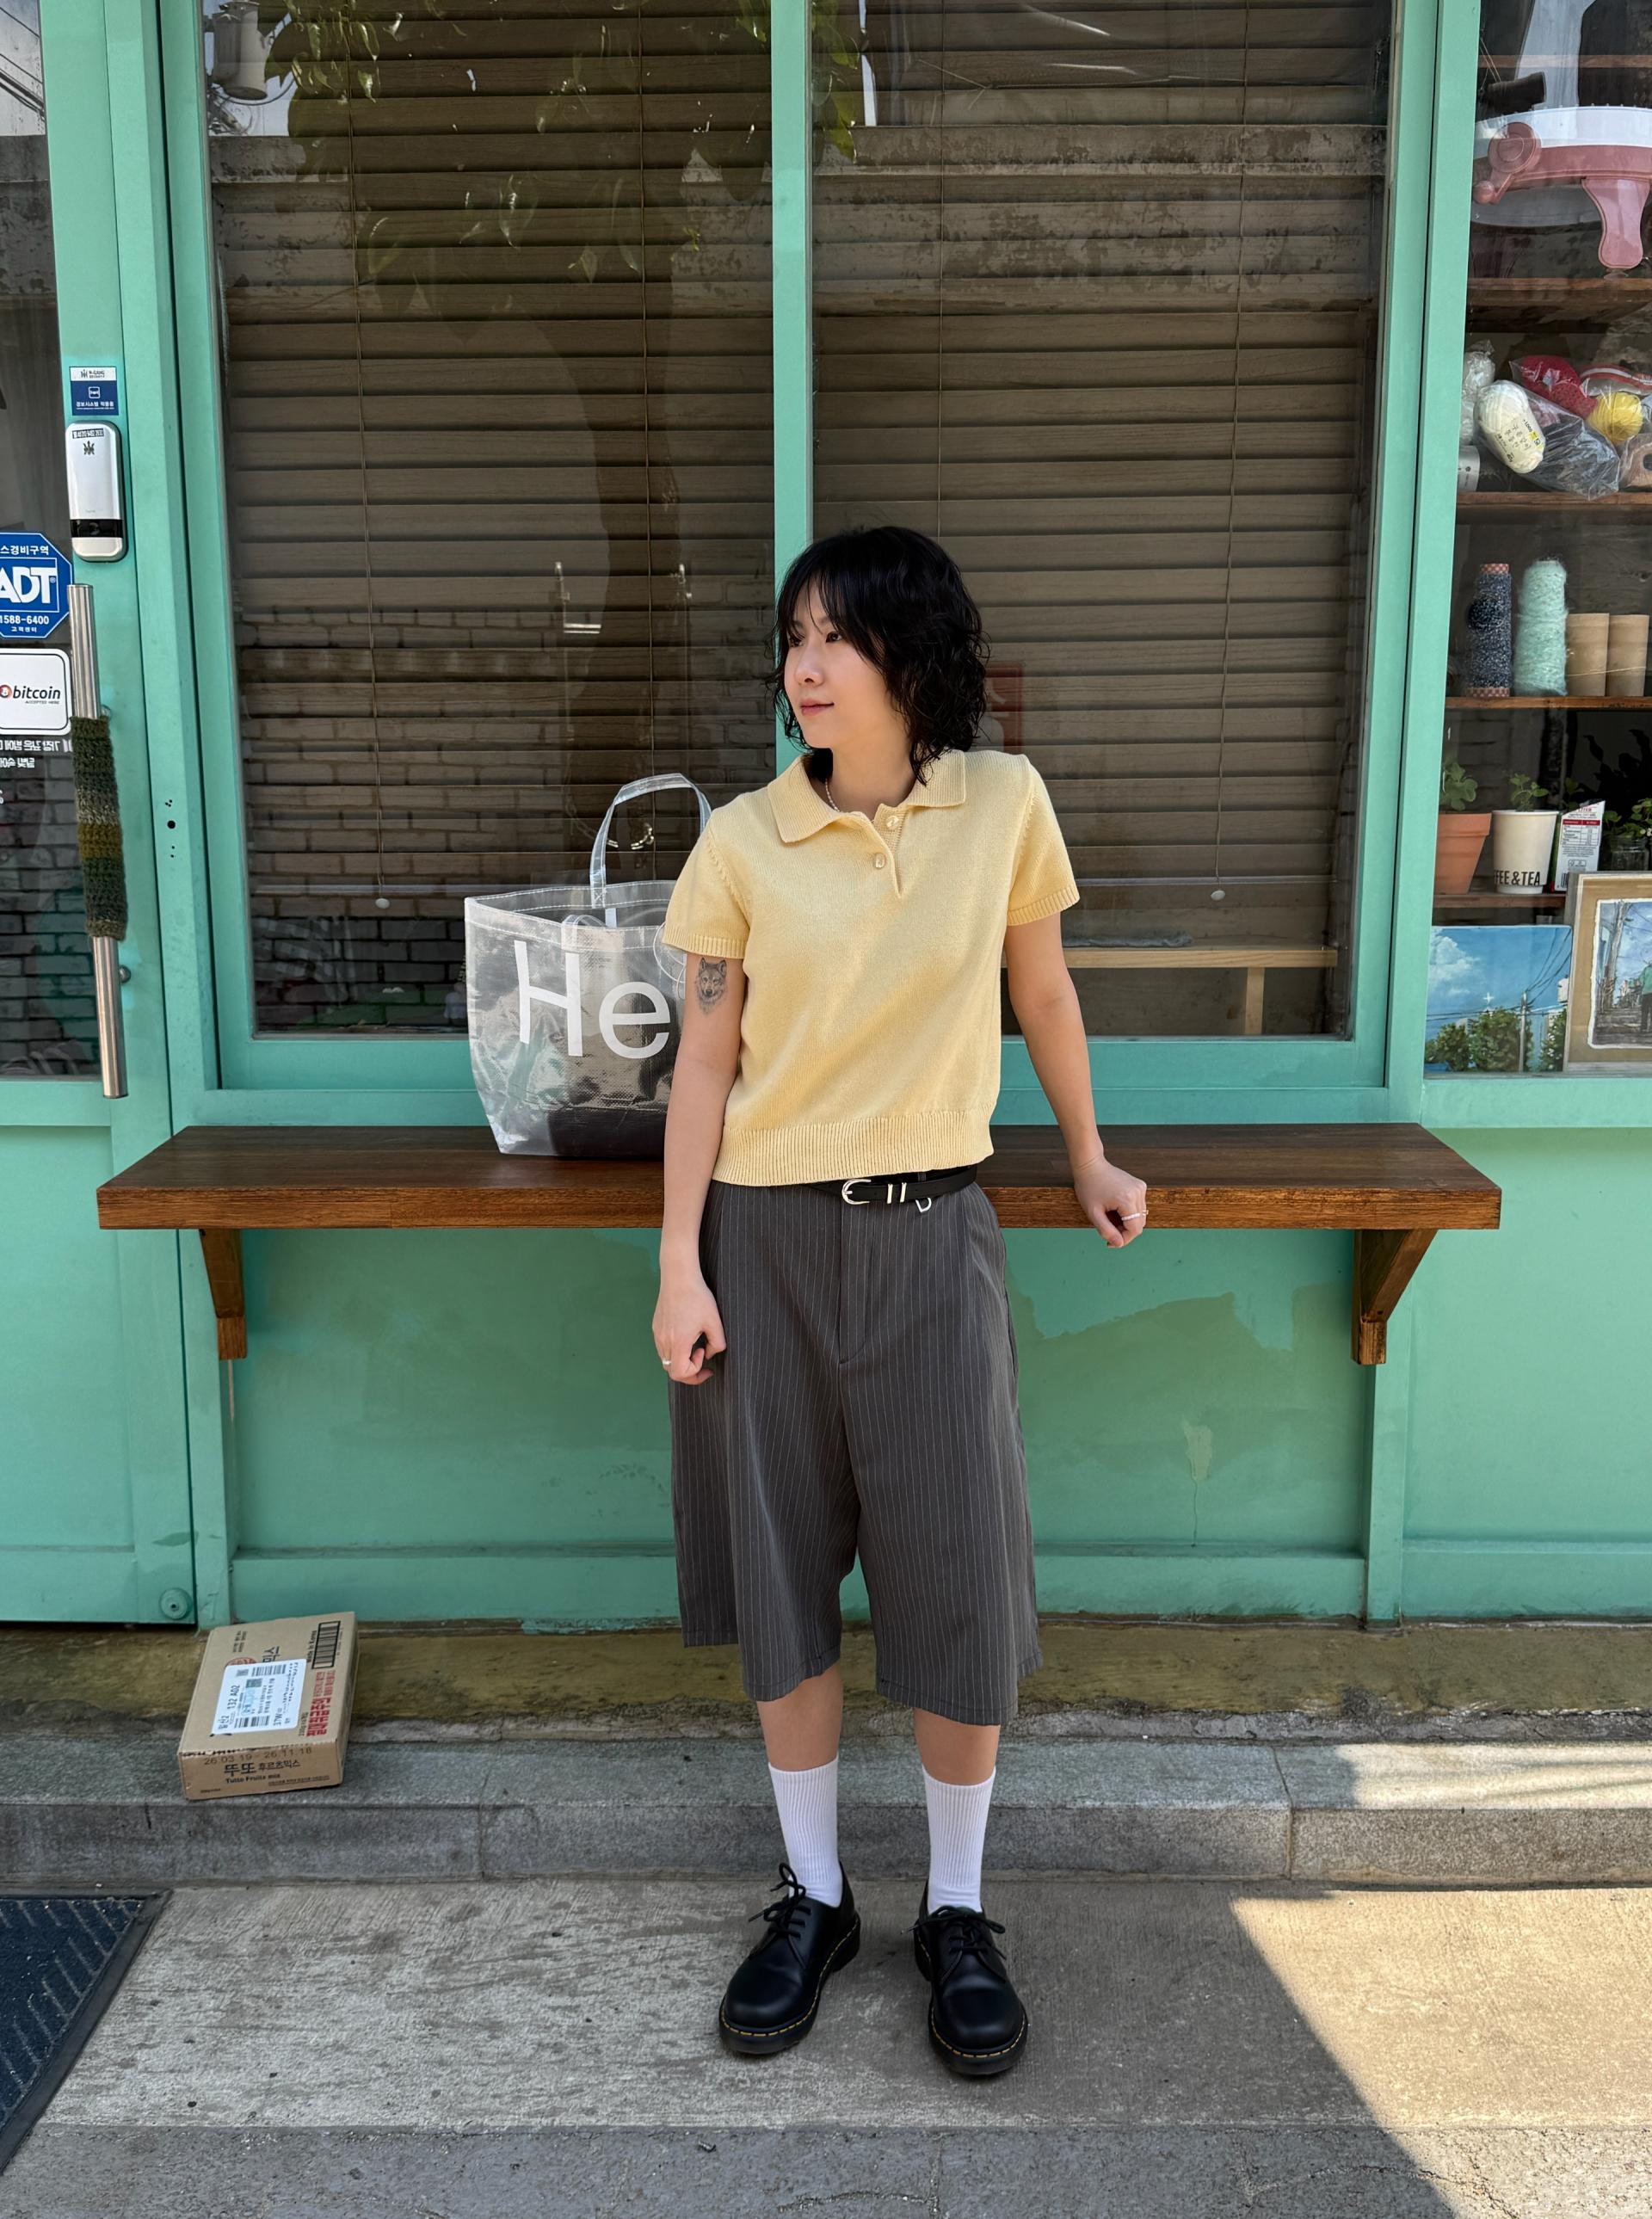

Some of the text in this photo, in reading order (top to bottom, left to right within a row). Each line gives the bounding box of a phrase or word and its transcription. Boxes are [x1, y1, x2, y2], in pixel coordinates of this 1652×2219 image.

[0, 566, 57, 603] ADT
[0, 615, 49, 625] 1588-6400
[12, 685, 61, 700] bitcoin
[1494, 870, 1510, 885] FEE
[514, 940, 671, 1059] He
